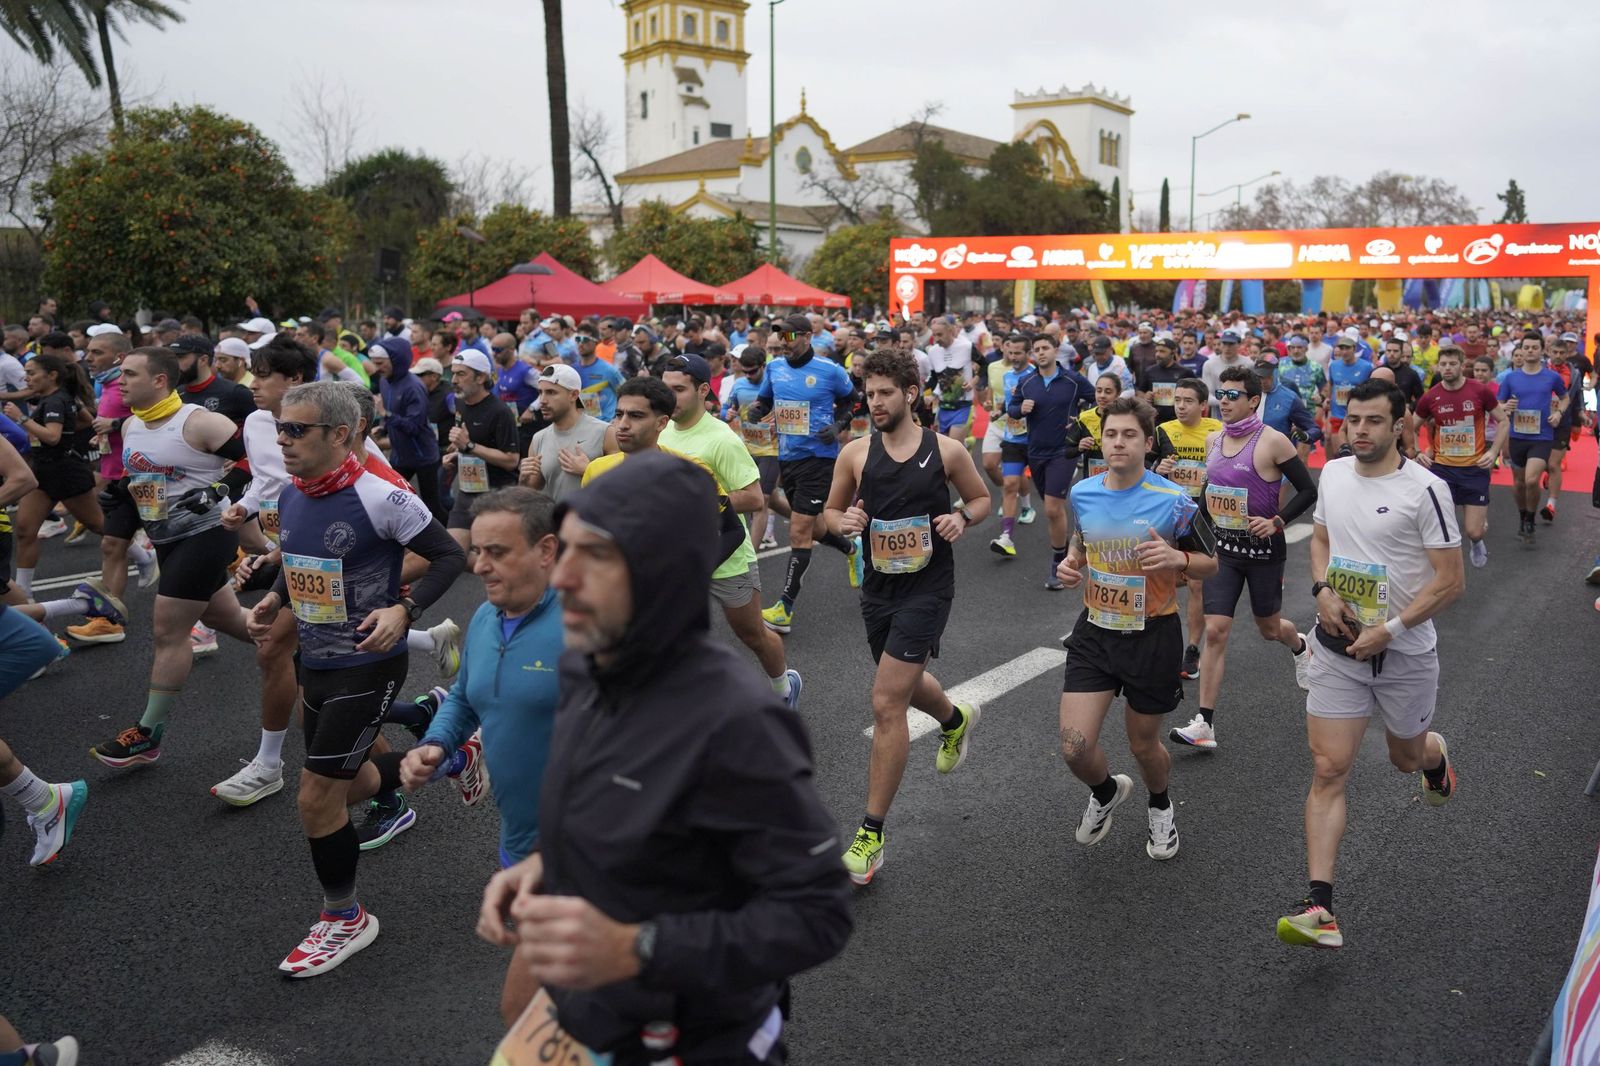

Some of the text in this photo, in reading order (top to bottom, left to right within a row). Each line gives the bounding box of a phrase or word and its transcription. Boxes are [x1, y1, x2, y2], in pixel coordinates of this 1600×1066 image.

[779, 409, 801, 420] 4363
[1445, 434, 1467, 443] 5740
[1174, 468, 1198, 481] 6541
[1211, 496, 1237, 511] 7708
[878, 532, 917, 551] 7693
[290, 571, 325, 595] 5933
[1330, 571, 1377, 598] 12037
[1094, 584, 1129, 606] 7874
